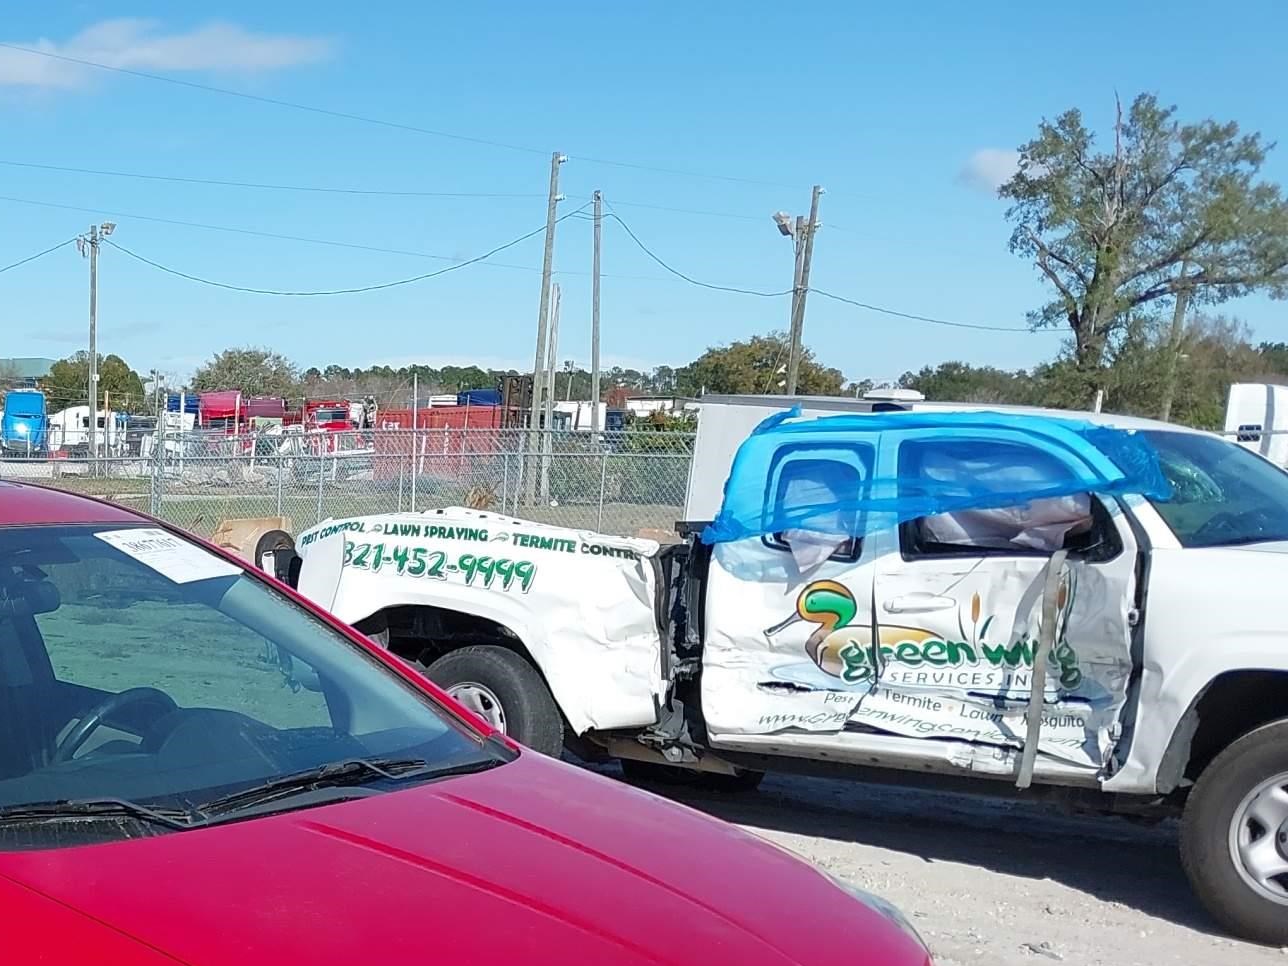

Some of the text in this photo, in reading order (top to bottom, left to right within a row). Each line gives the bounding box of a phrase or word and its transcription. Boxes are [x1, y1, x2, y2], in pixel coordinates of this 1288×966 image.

[319, 522, 366, 540] CONTROL
[384, 523, 489, 543] LAWN SPRAYING
[512, 532, 642, 561] TERMITE CONTRO
[344, 541, 536, 593] 321-452-9999
[823, 692, 855, 704] Pest
[883, 688, 942, 712] Termite
[960, 703, 1004, 723] Lawn
